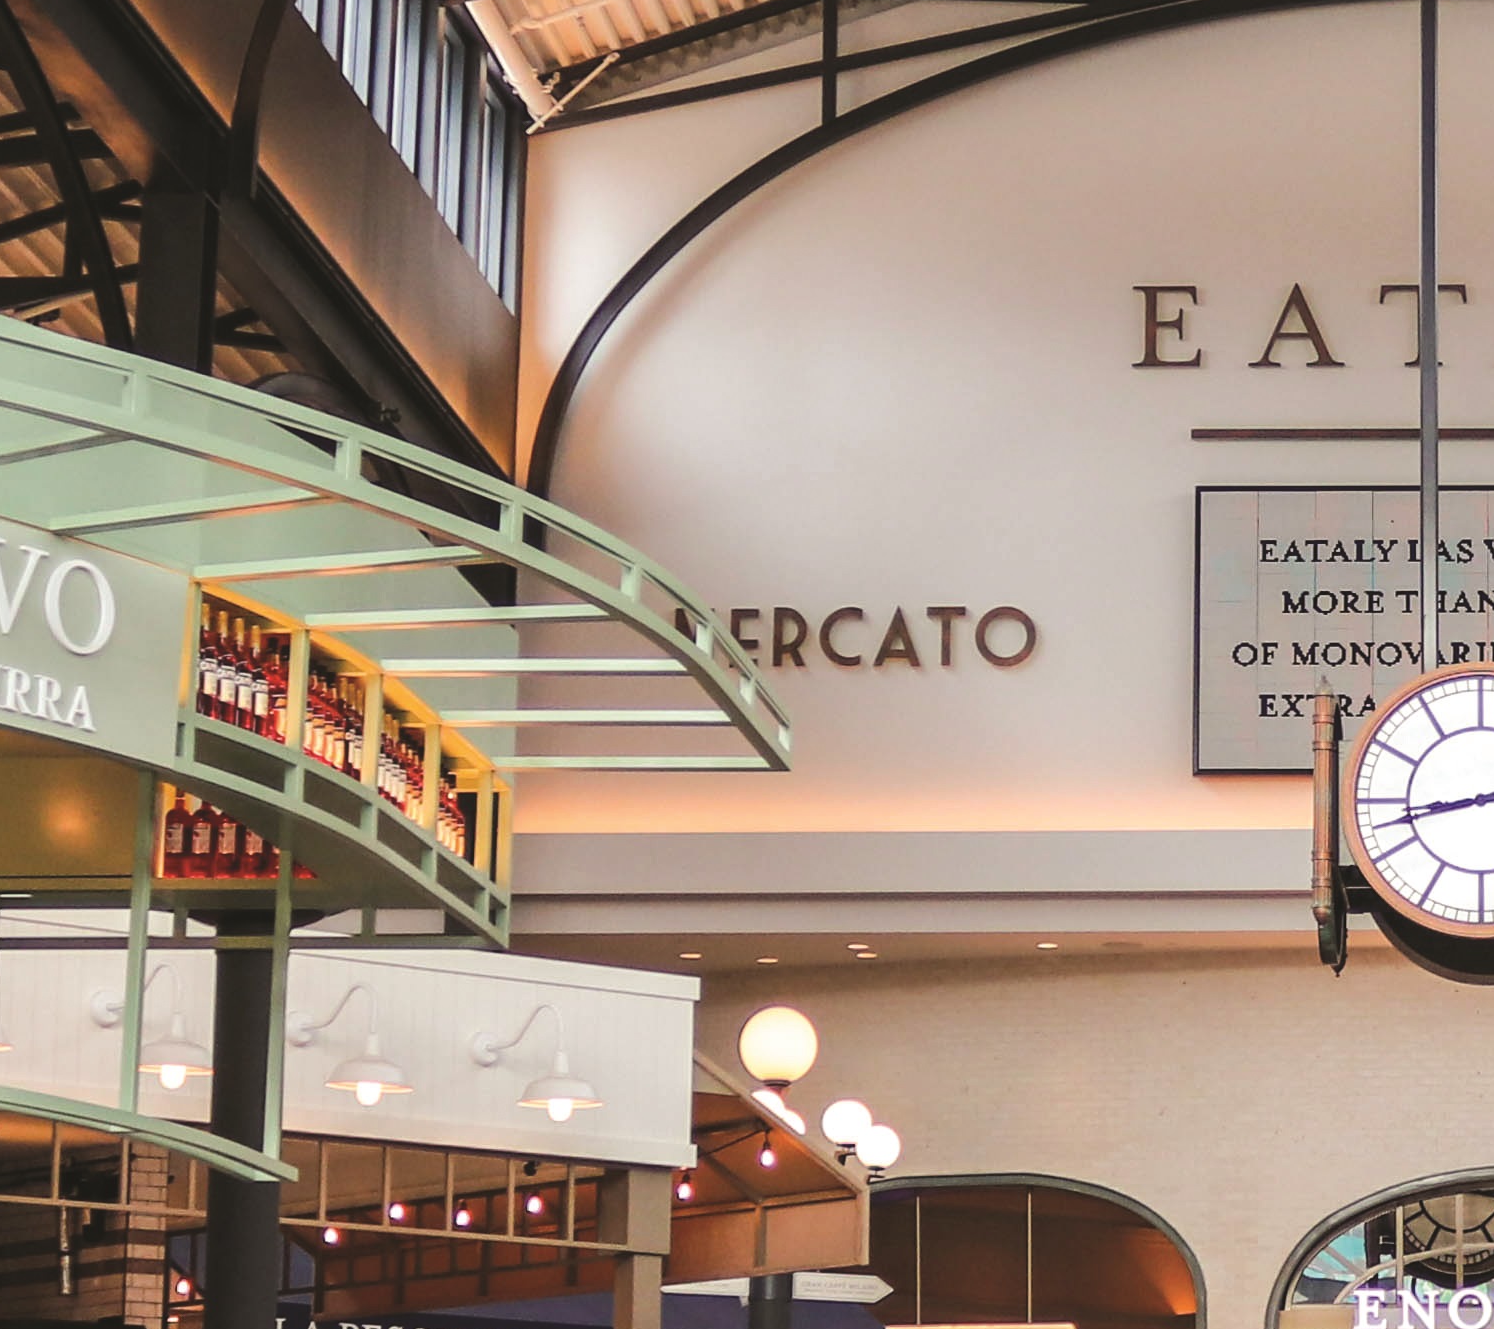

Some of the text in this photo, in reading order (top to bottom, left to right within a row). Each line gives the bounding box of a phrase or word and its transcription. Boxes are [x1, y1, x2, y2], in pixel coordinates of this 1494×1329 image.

[1259, 539, 1398, 563] EATALY
[1407, 538, 1474, 563] LAS
[1282, 590, 1385, 615] MORE
[1232, 641, 1279, 667] OF
